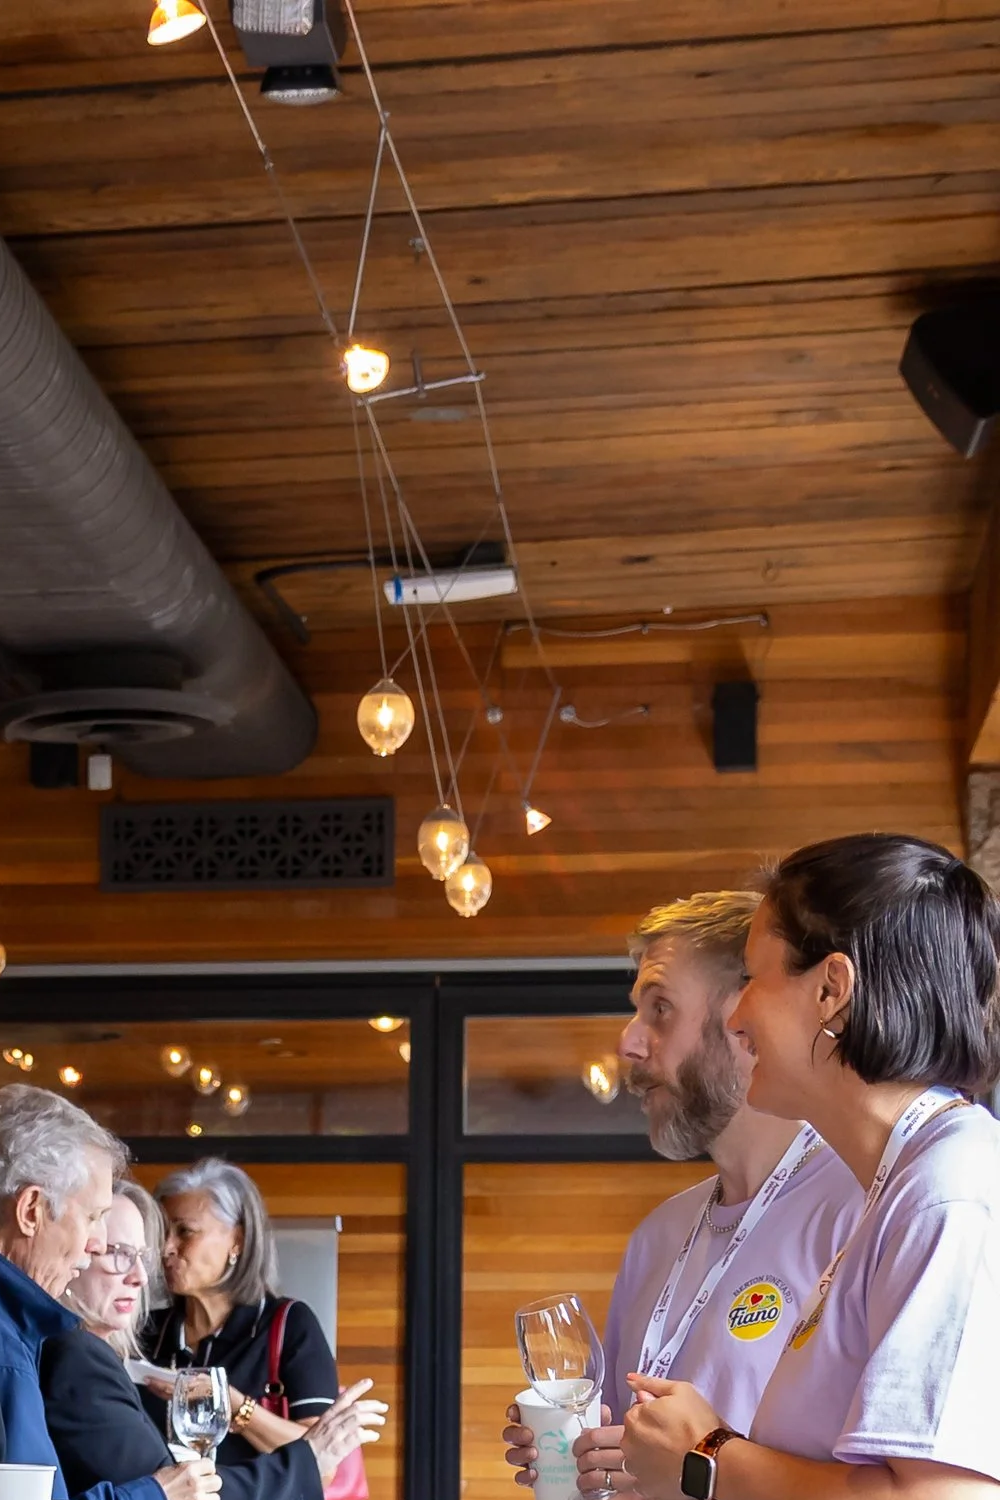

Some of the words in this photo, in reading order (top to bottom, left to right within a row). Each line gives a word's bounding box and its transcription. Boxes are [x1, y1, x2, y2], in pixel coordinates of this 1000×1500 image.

[733, 1275, 764, 1297] BERTON
[765, 1274, 793, 1304] VINEYARD
[728, 1306, 779, 1328] Fiano
